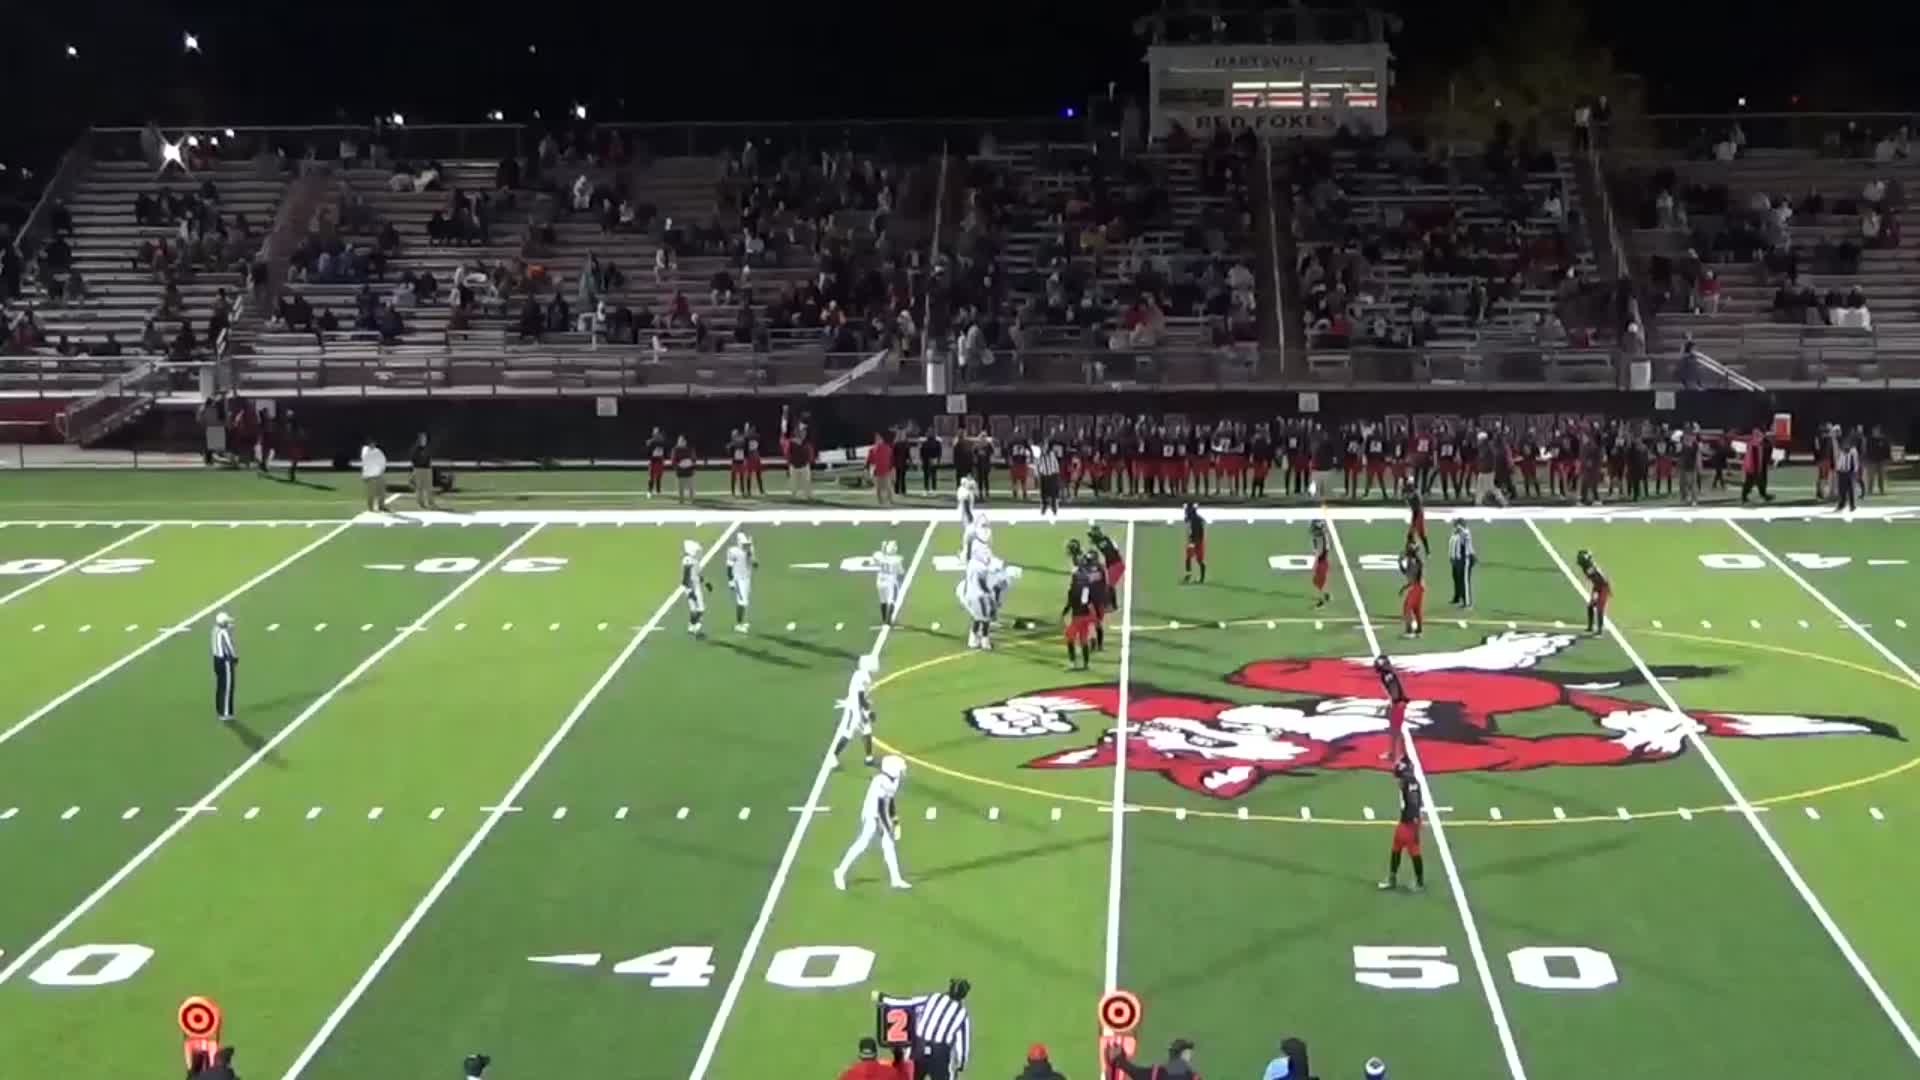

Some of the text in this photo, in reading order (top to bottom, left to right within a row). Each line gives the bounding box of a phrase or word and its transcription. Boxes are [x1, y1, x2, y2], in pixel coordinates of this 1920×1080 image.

[1196, 113, 1337, 130] RED FOXES
[886, 1007, 909, 1043] 2
